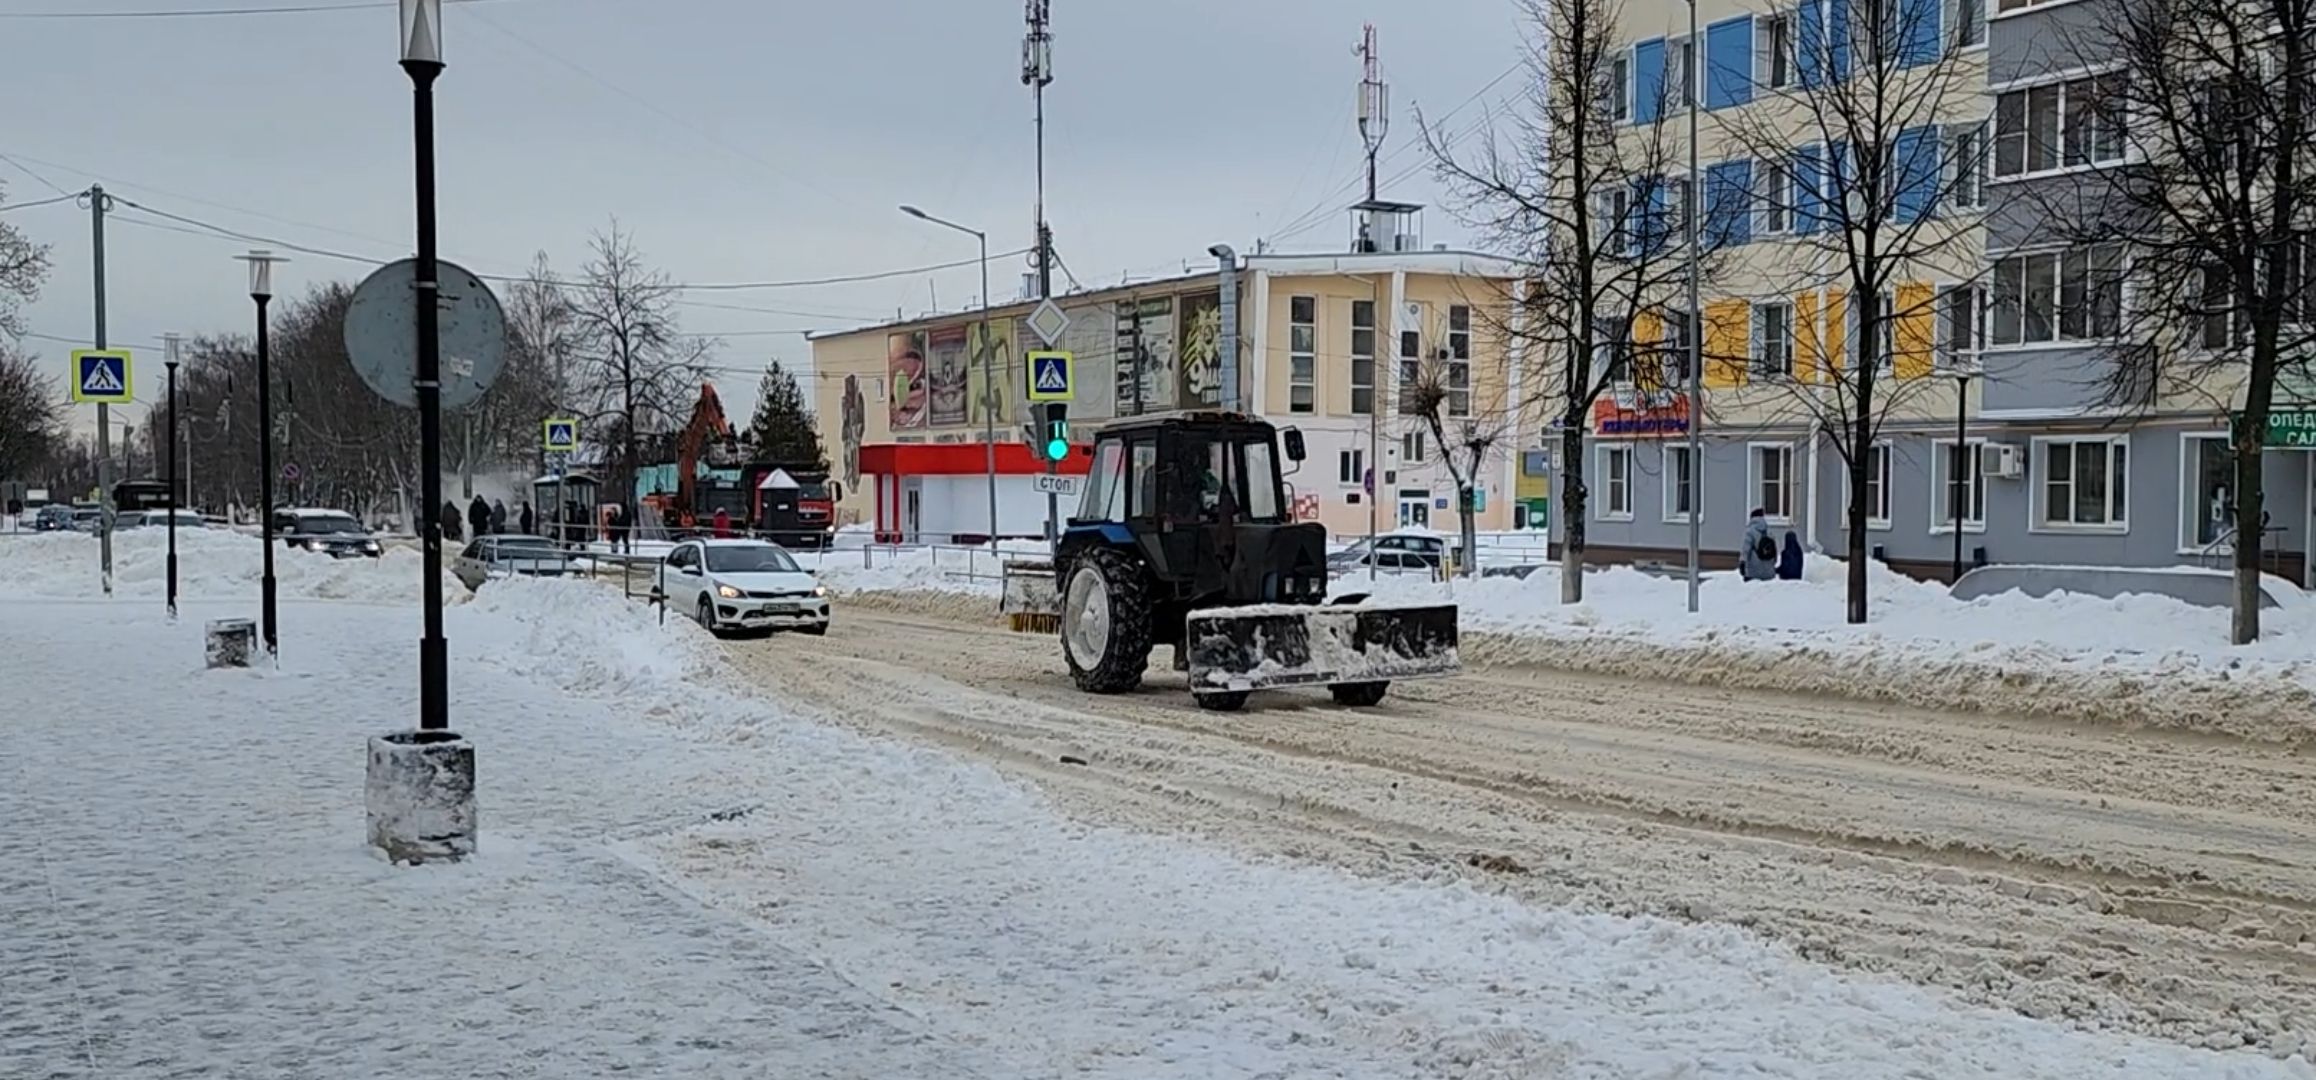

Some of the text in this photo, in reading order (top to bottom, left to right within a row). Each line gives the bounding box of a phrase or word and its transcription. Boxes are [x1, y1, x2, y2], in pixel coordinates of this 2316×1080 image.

[1188, 359, 1203, 395] 9
[2269, 413, 2316, 429] ОПЕД
[1040, 476, 1070, 491] СТОП
